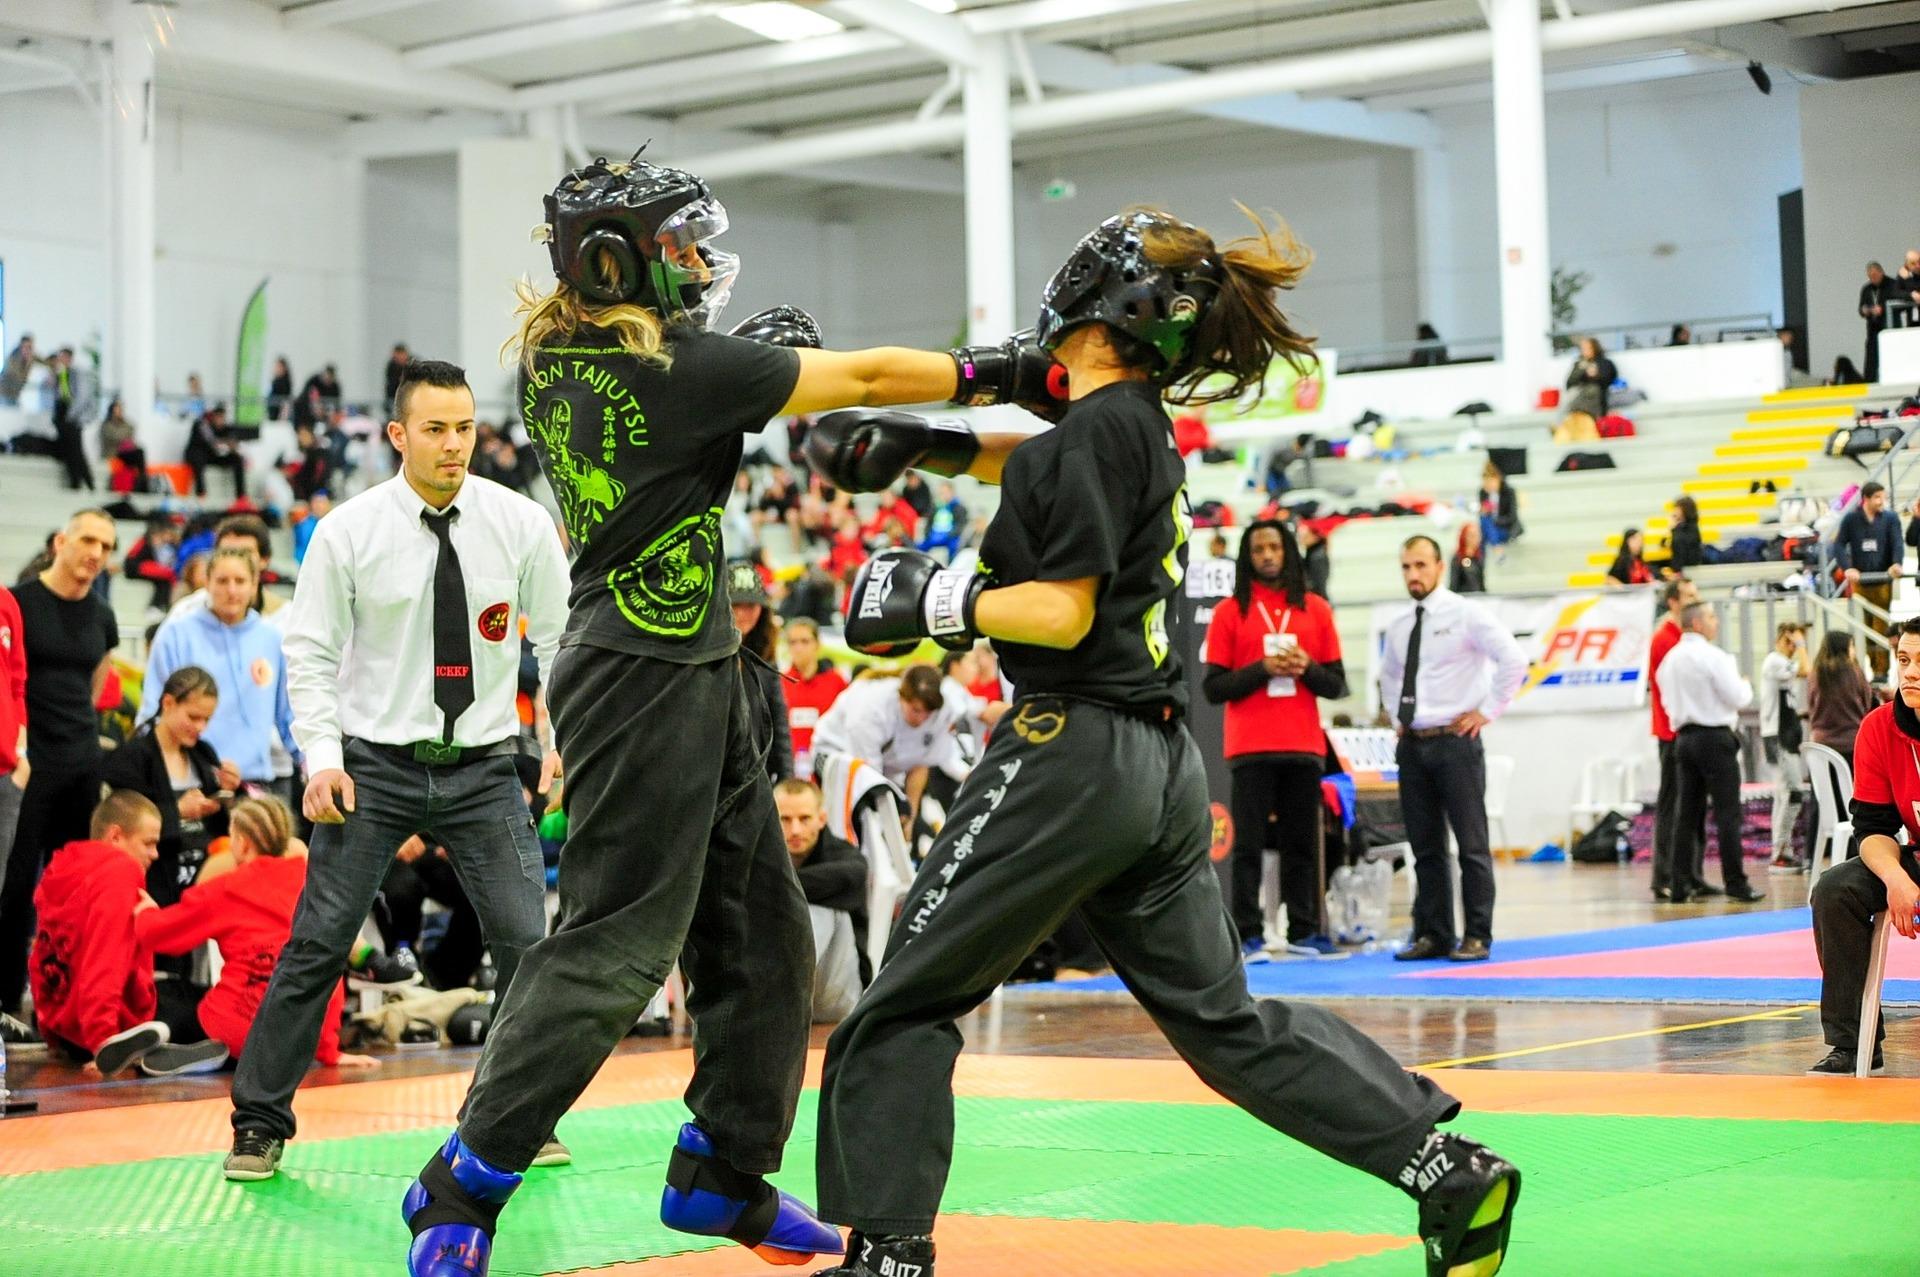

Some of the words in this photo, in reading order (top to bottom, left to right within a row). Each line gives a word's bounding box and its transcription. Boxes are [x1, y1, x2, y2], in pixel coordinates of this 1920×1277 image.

[523, 360, 563, 443] NINPON
[571, 360, 649, 446] TAIJUTSU
[1416, 1151, 1455, 1193] BLITZ
[880, 1255, 922, 1277] BLITZ
